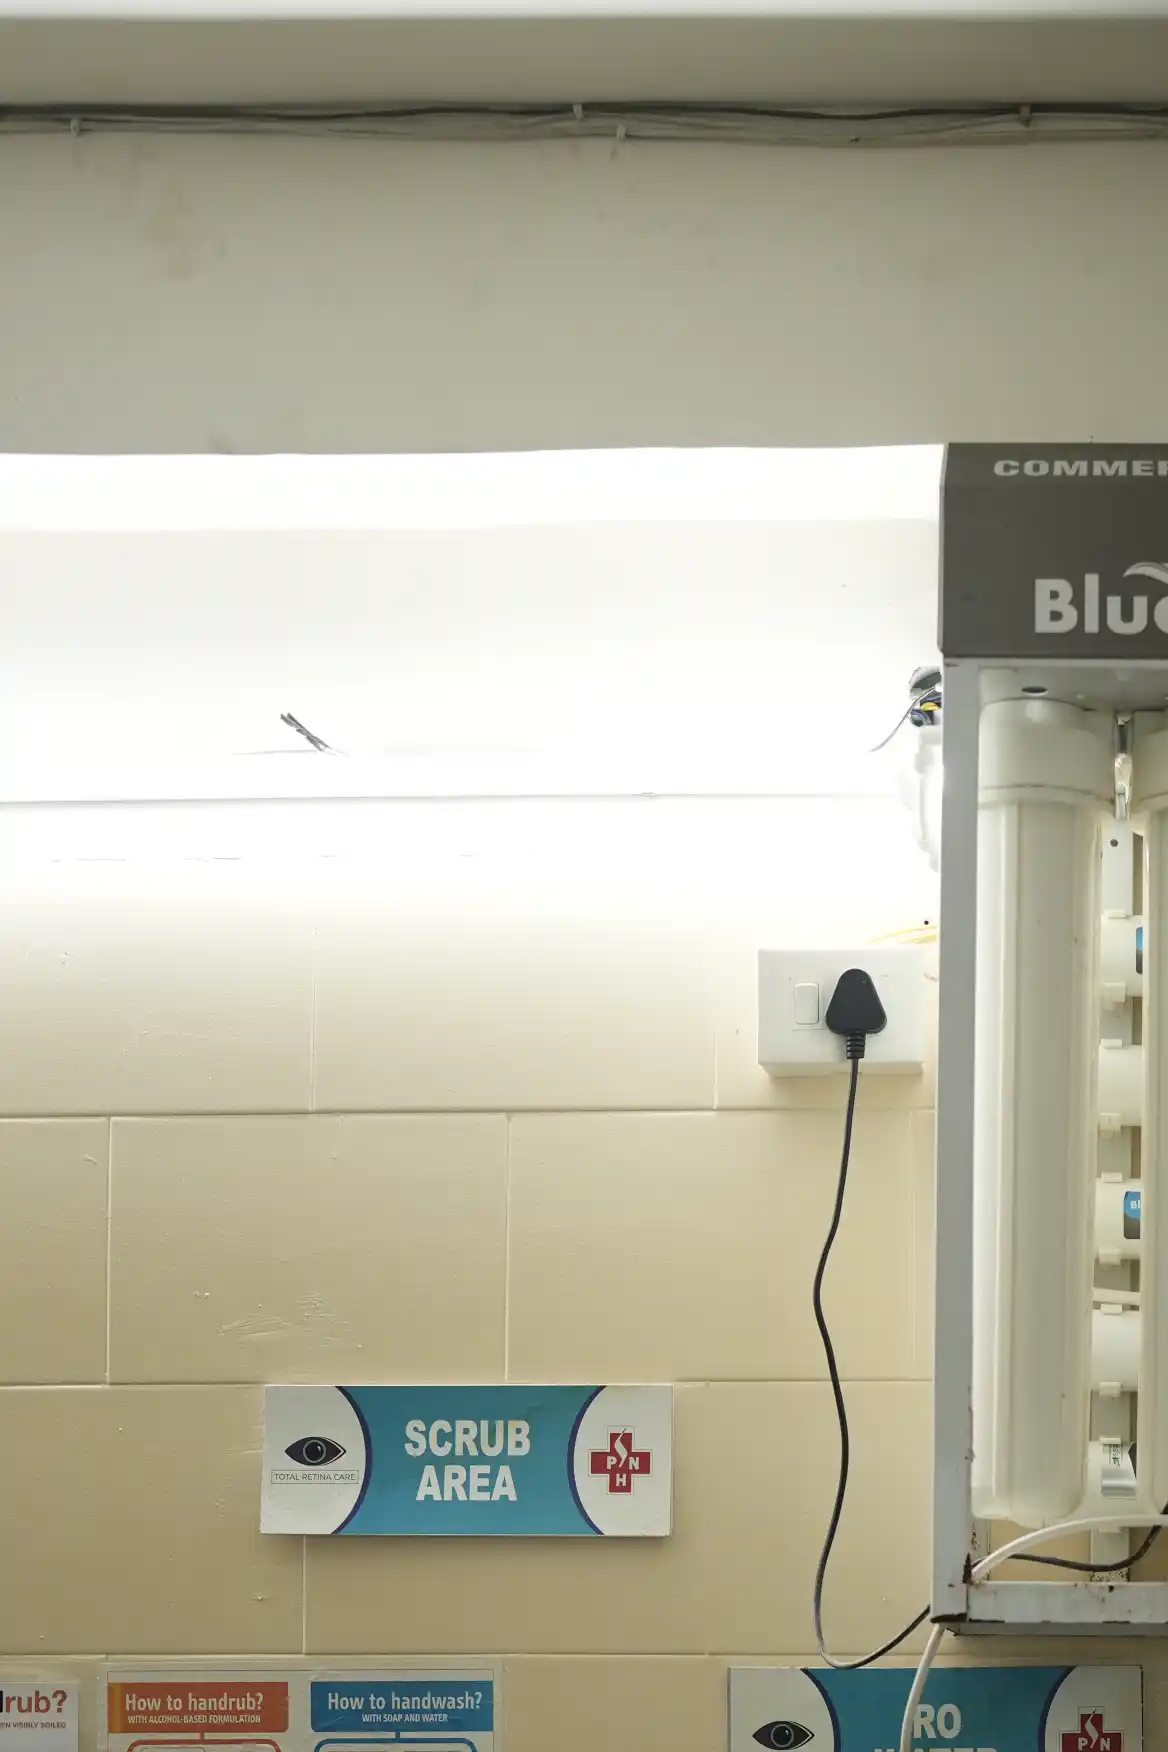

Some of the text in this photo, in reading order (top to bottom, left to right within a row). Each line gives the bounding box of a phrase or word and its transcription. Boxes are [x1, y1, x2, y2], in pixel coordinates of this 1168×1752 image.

[404, 1419, 530, 1457] SCRUB
[606, 1456, 639, 1469] P N
[415, 1465, 517, 1501] AREA
[615, 1474, 626, 1487] H
[126, 1692, 264, 1711] How to handrub?
[328, 1691, 483, 1710] How to handwash?
[127, 1714, 261, 1724] WITH ALCOHOL-BASED FORMULATION
[362, 1714, 448, 1723] WITH SOAP AND WATER
[913, 1704, 961, 1739] RO
[1078, 1738, 1111, 1751] P N
